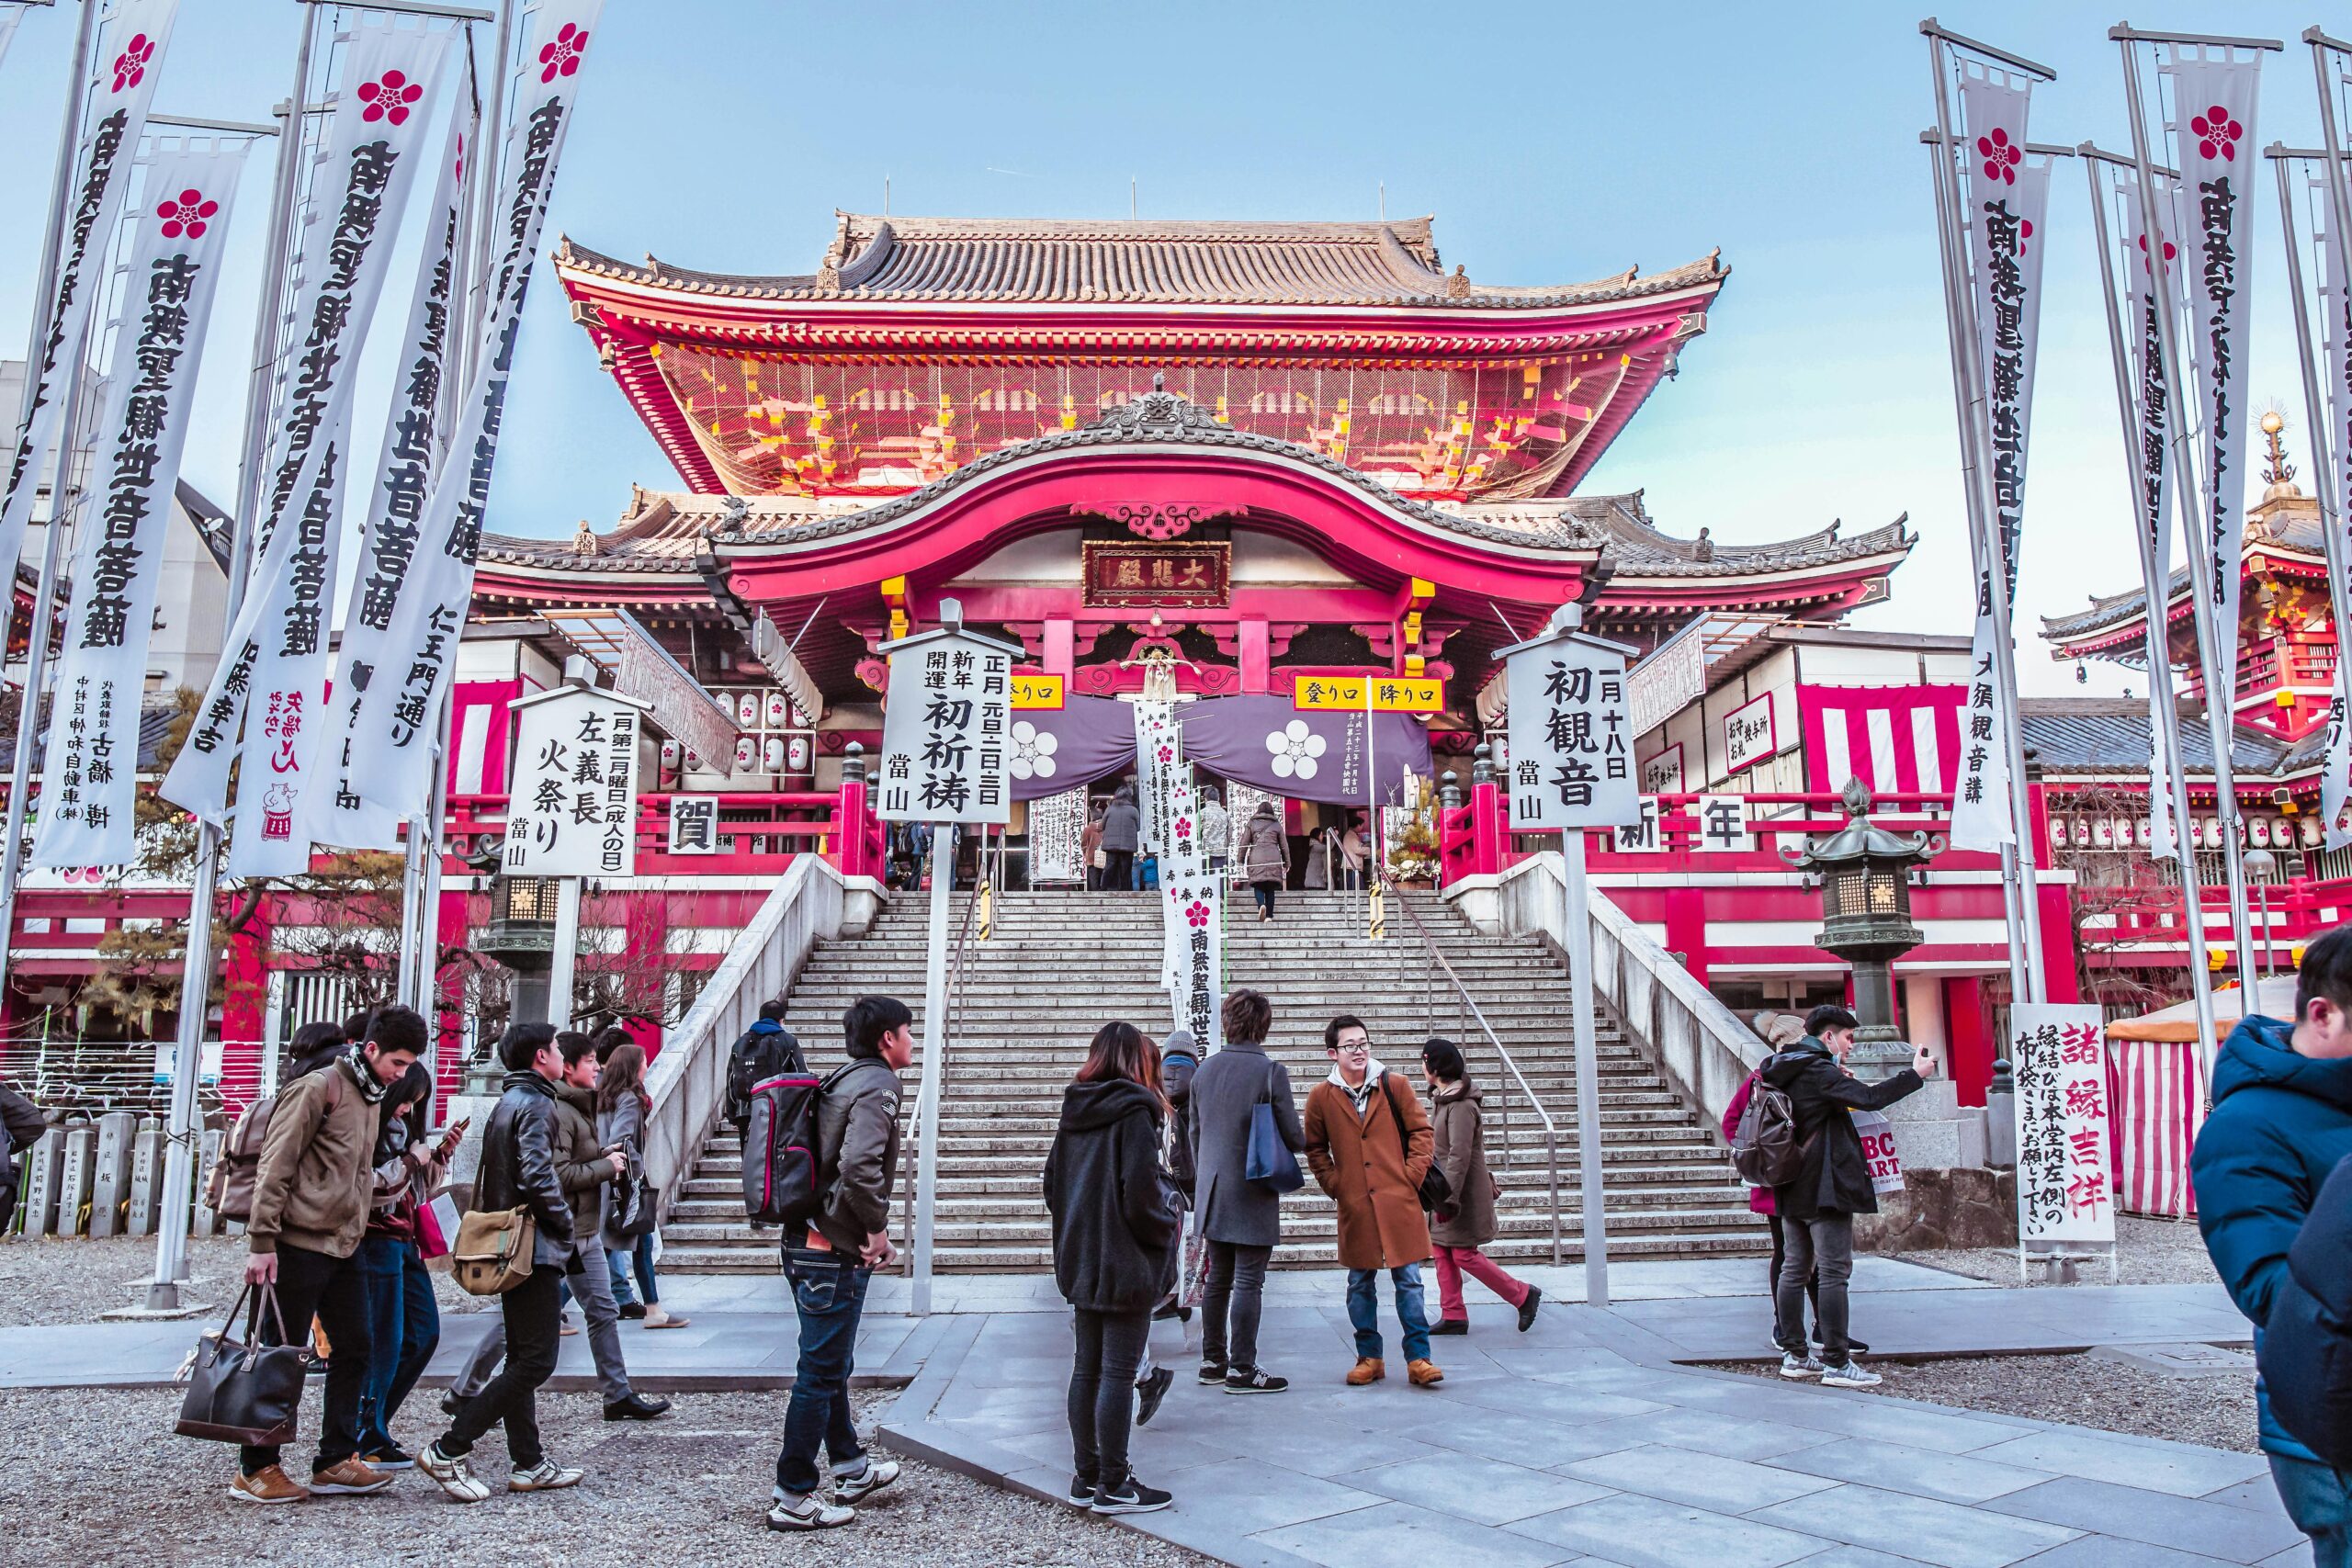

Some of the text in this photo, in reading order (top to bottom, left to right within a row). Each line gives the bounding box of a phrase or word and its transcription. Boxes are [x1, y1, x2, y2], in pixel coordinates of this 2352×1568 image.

[391, 603, 458, 748] 仁王門通り
[924, 650, 948, 690] 開運
[952, 650, 976, 691] 新年
[1305, 682, 1358, 704] 登り口
[1380, 684, 1434, 705] 降り口
[918, 693, 974, 815] 初祈祷
[1544, 660, 1600, 807] 初観音
[1599, 668, 1627, 780] 一月十八日
[532, 739, 569, 854] 火祭り
[569, 711, 606, 825] 左義長
[886, 752, 912, 813] 當山
[1517, 759, 1542, 821] 當山
[508, 817, 530, 867] 當山
[673, 800, 713, 851] 賀
[1704, 799, 1744, 849] 年
[1180, 886, 1214, 902] 奉納
[1190, 929, 1213, 1064] 南無聖観世音
[2036, 1024, 2066, 1225] 縁結びは本堂内左側の
[2061, 1022, 2109, 1224] 諸縁吉祥
